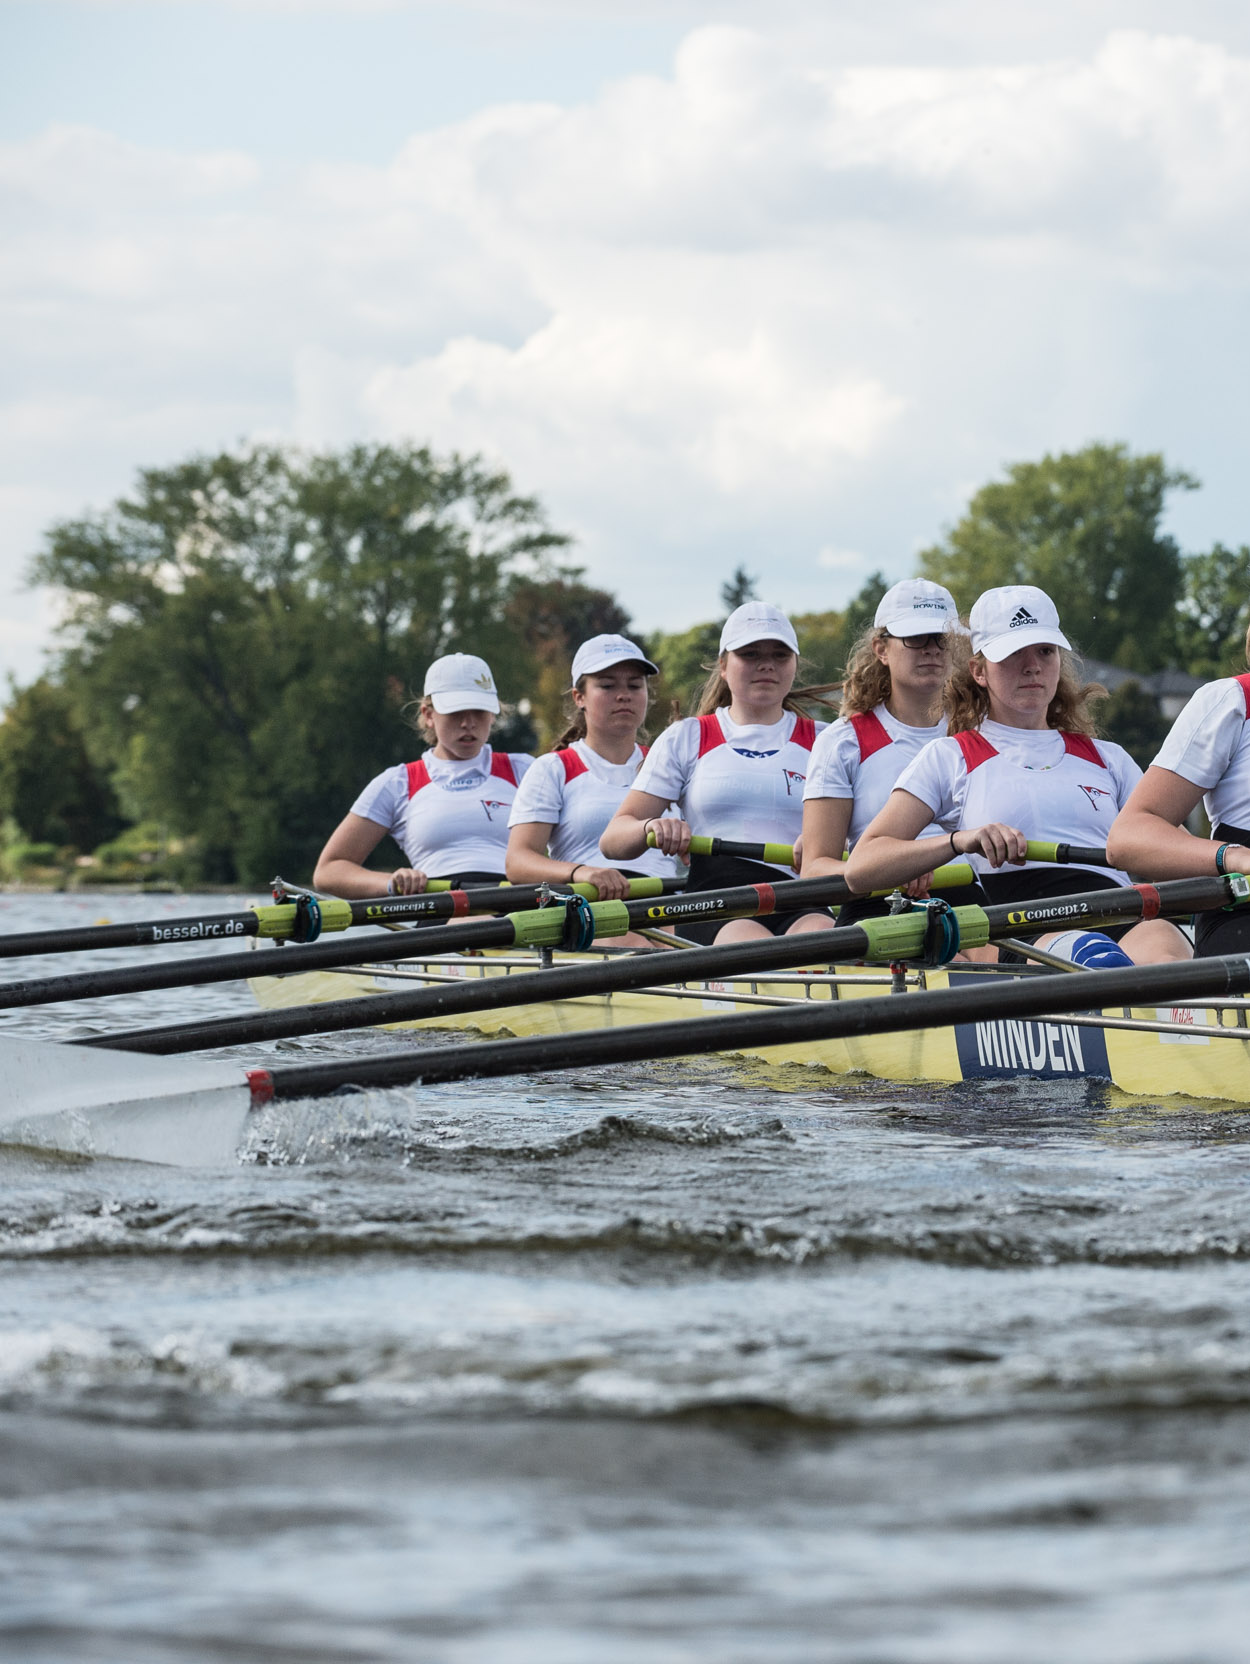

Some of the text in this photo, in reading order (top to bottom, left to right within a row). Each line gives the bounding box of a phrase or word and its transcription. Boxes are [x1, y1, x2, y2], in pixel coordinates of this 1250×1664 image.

[913, 603, 947, 611] ROWING
[1009, 617, 1038, 629] adidas
[382, 901, 435, 914] concept 2
[665, 900, 716, 915] concept
[716, 899, 724, 908] 2
[1026, 904, 1079, 920] concept
[1080, 902, 1088, 912] 2
[152, 919, 245, 942] besselrc.de
[975, 1019, 1086, 1073] MINDEN
